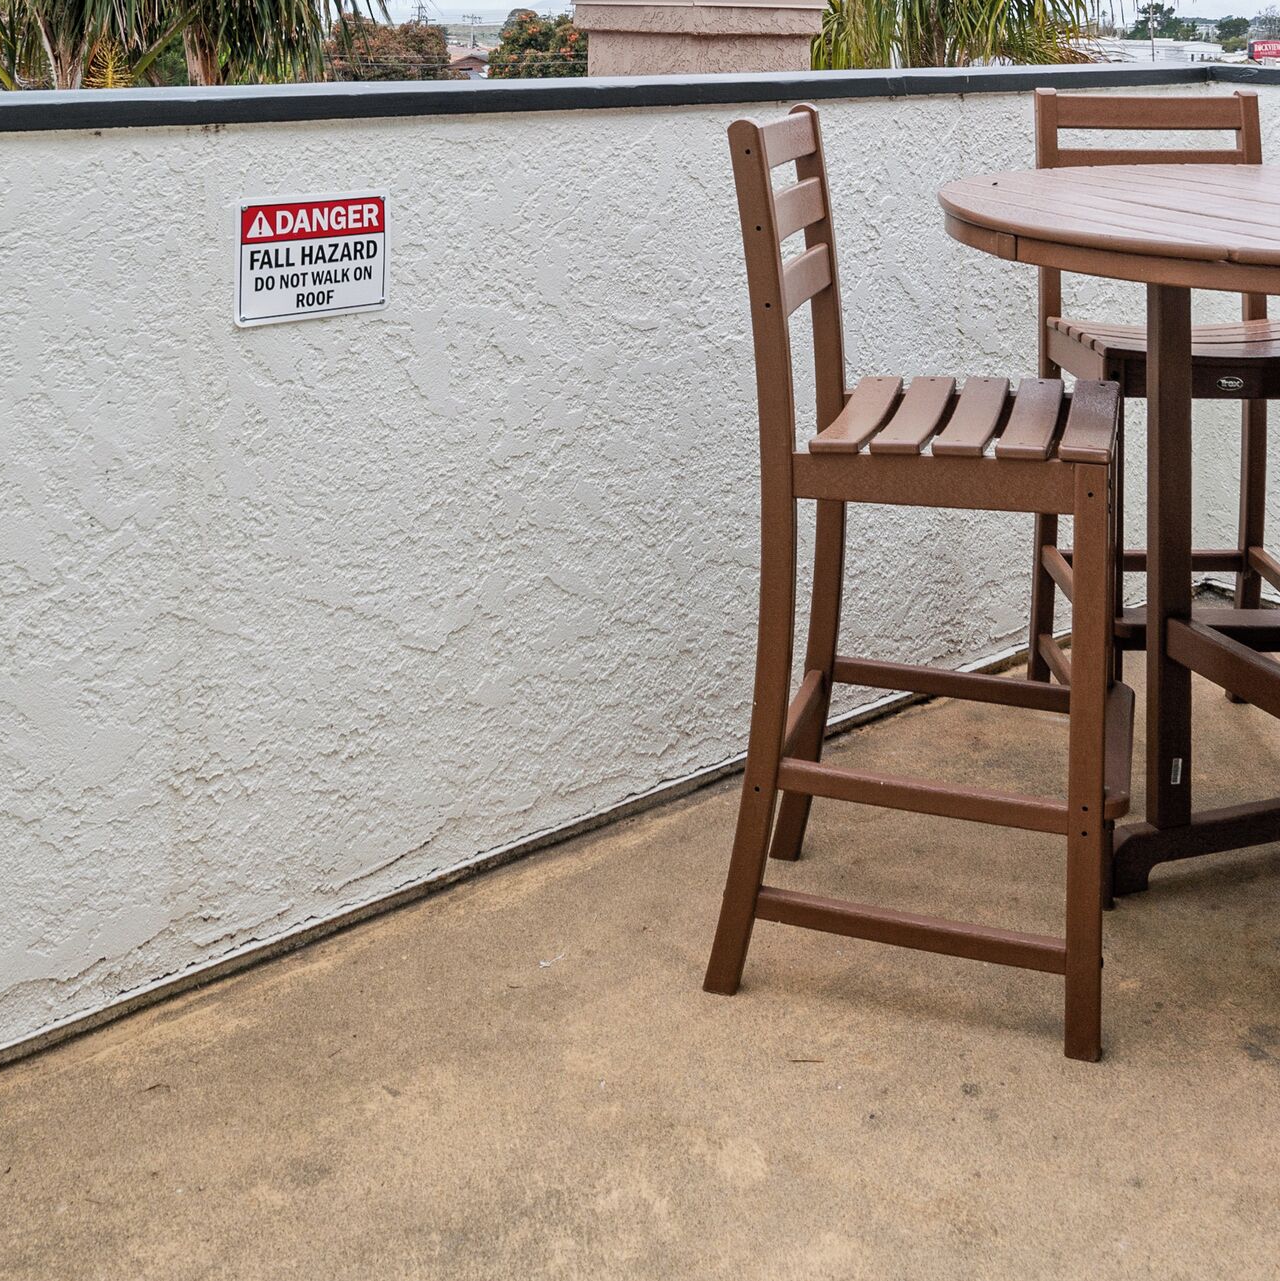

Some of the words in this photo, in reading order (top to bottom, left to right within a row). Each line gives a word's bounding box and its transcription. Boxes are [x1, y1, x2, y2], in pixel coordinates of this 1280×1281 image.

[276, 203, 379, 235] DANGER
[249, 247, 295, 271] FALL
[301, 240, 378, 266] HAZARD
[254, 276, 275, 292] DO
[280, 272, 308, 289] NOT
[311, 268, 350, 286] WALK
[353, 265, 373, 281] ON
[296, 289, 334, 308] ROOF
